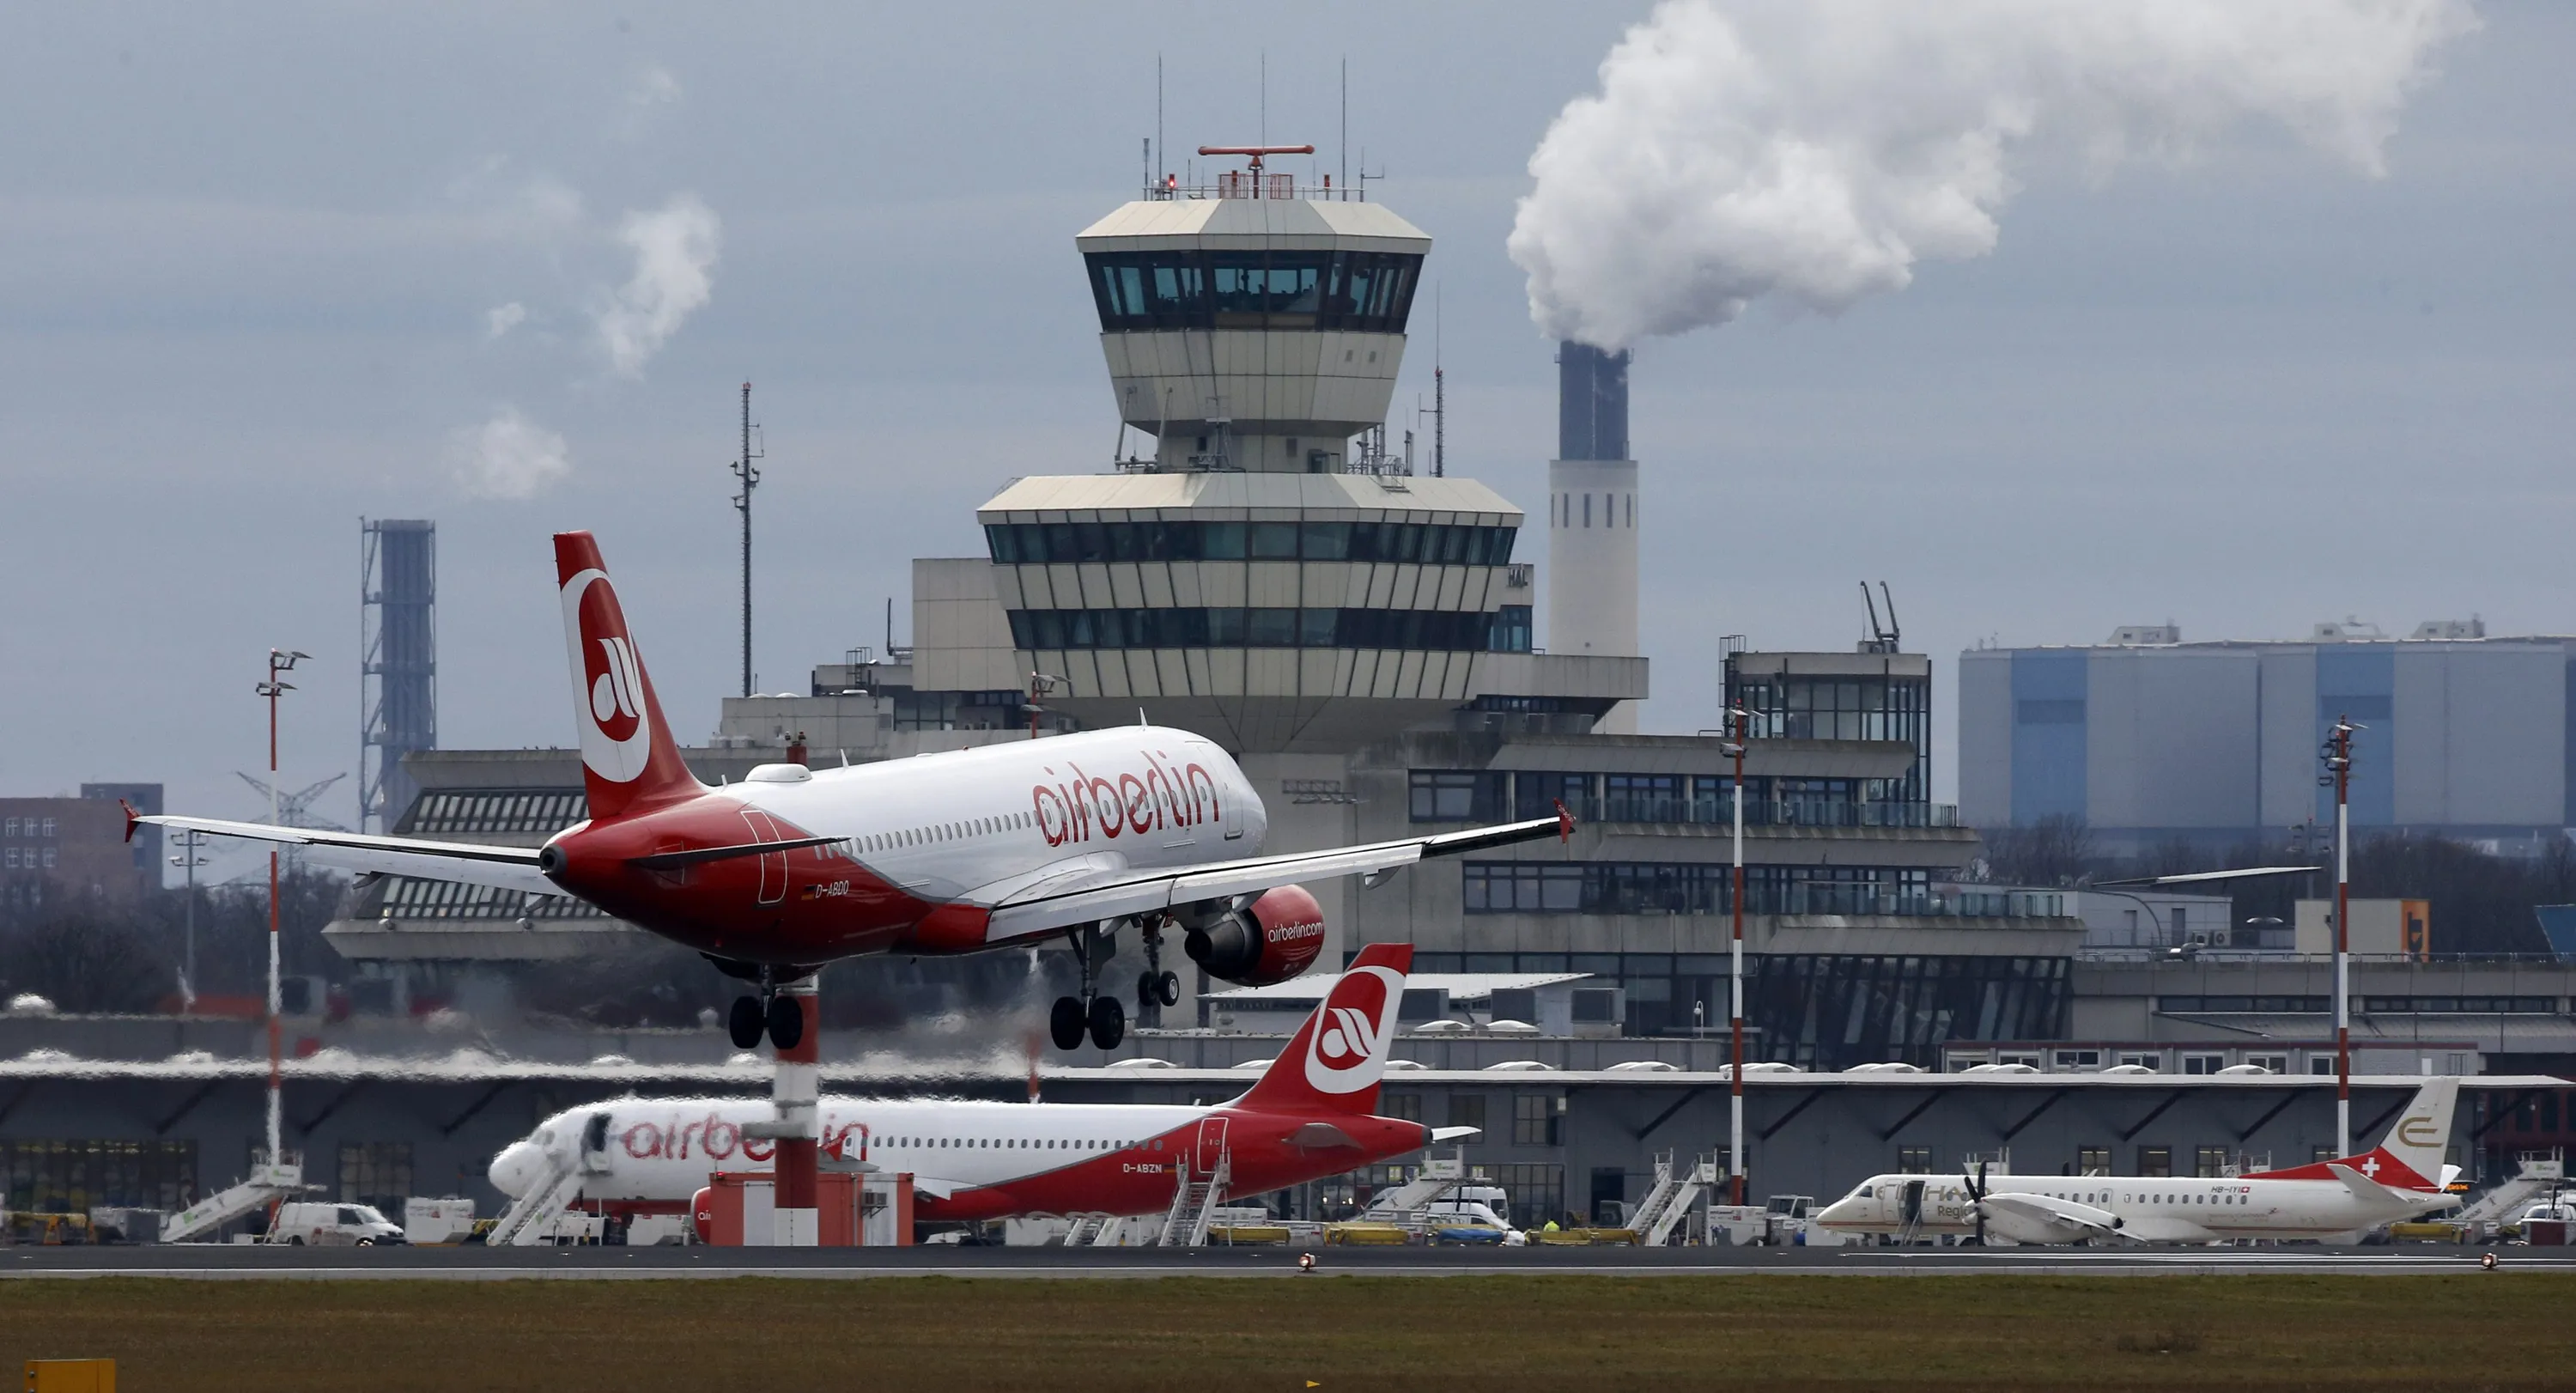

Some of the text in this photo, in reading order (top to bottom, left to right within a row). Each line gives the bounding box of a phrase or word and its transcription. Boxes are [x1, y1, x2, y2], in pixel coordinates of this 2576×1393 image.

[1033, 750, 1218, 847] airberlin
[815, 880, 849, 898] D-ABDO
[1268, 922, 1322, 942] airberlin.com
[623, 1112, 870, 1162] airbein
[1123, 1164, 1162, 1173] D-ABZN
